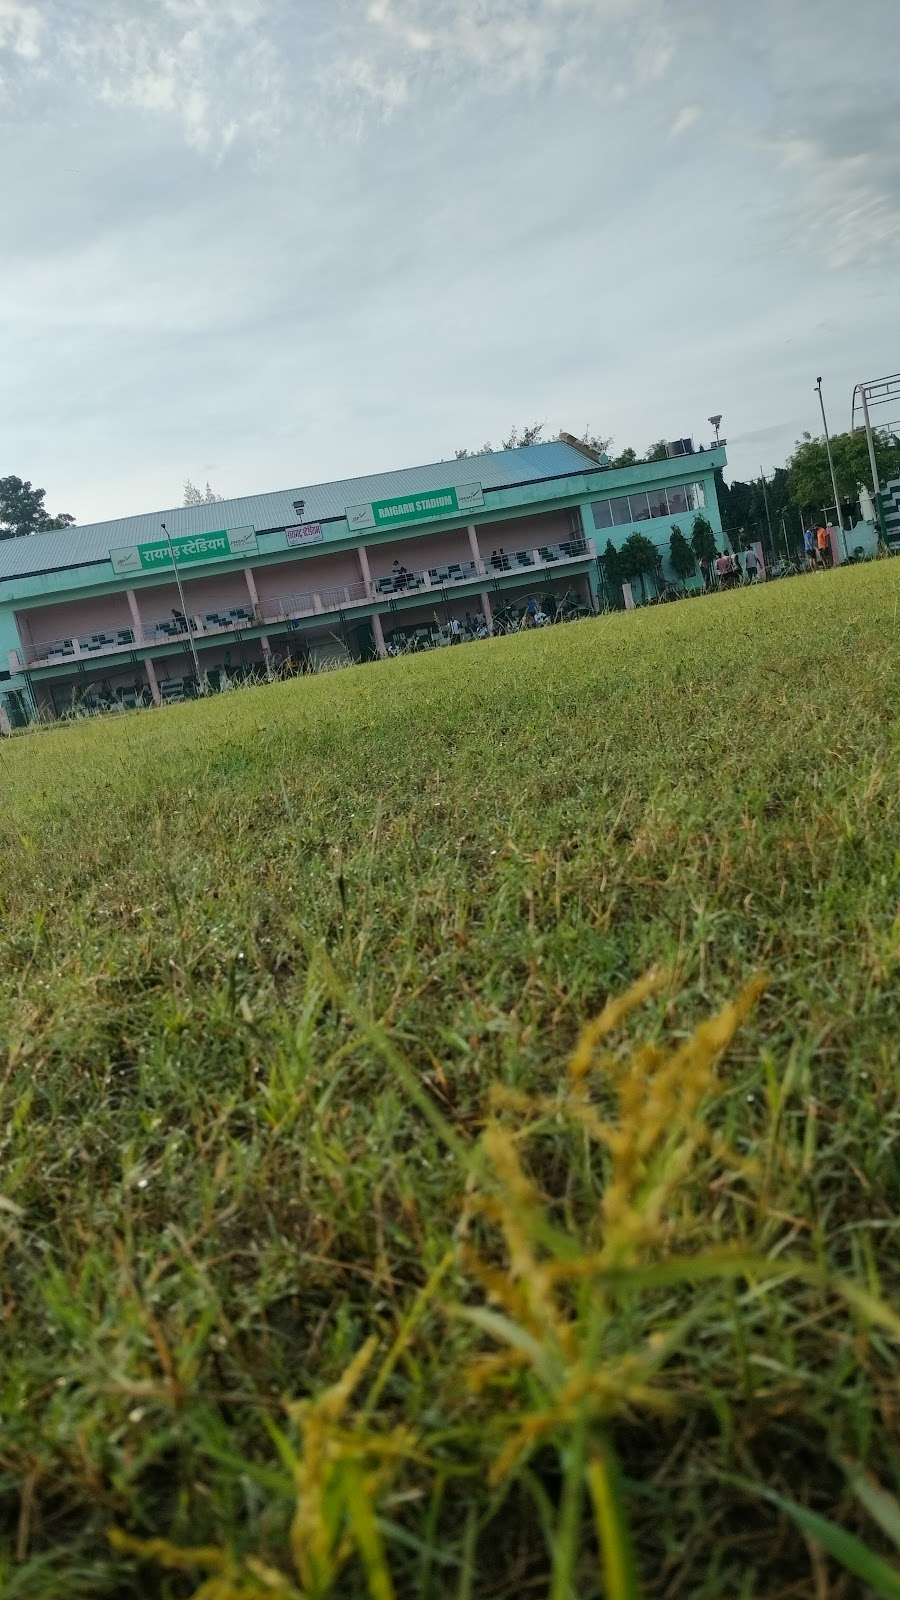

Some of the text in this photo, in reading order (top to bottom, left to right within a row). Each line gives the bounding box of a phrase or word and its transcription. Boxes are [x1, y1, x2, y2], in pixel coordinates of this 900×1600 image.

[378, 502, 415, 519] RAIGARH
[415, 495, 453, 511] STADIUM
[142, 546, 181, 562] रायगढ़
[181, 538, 226, 555] स्टेडियम
